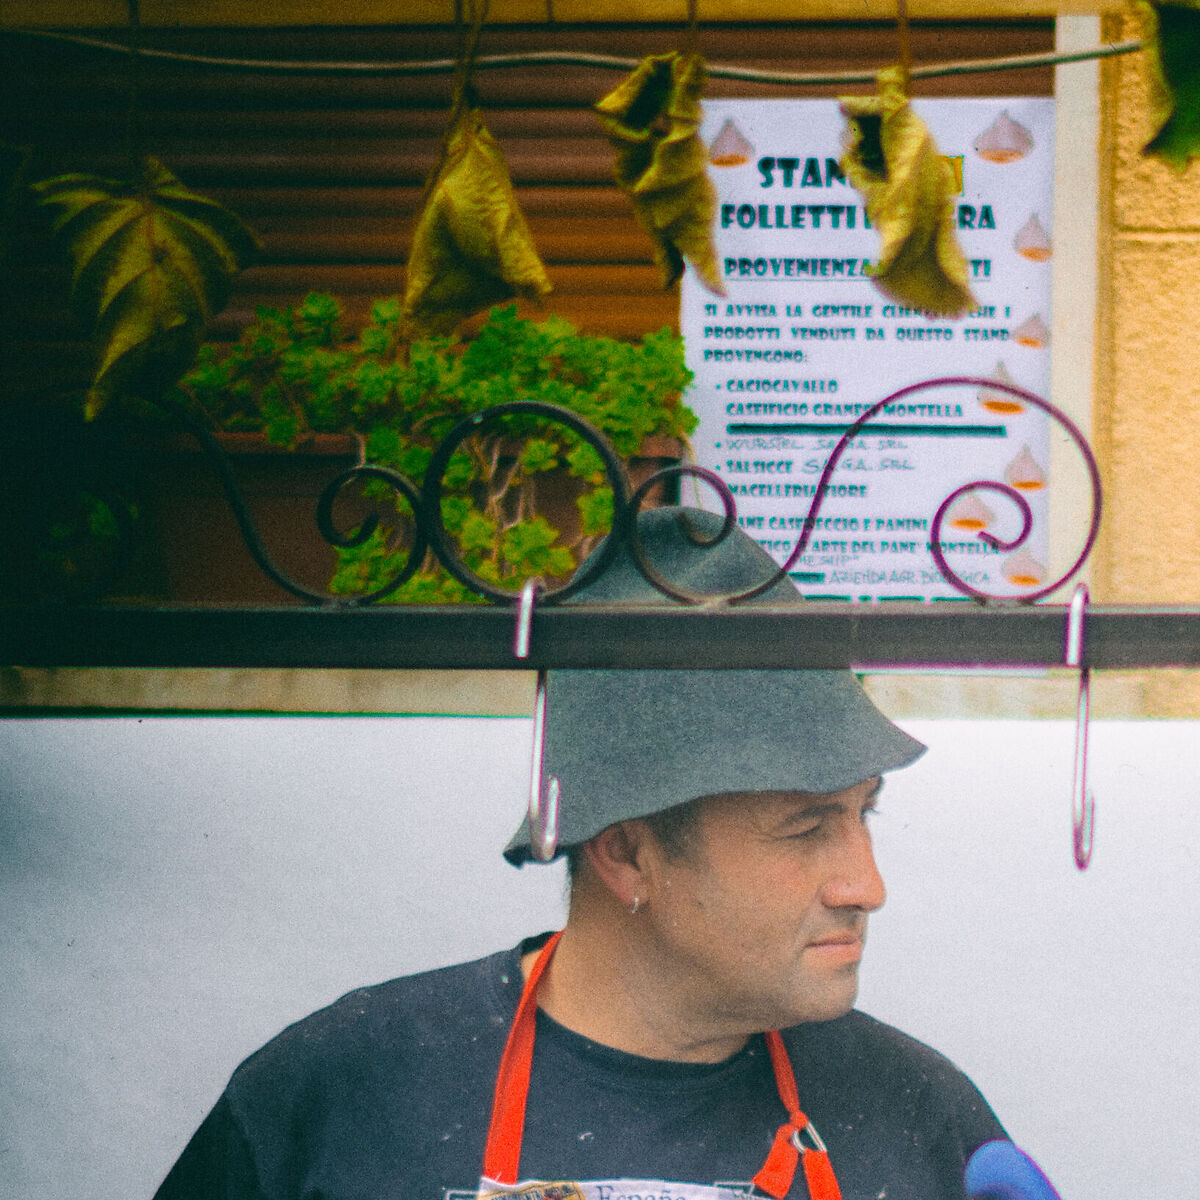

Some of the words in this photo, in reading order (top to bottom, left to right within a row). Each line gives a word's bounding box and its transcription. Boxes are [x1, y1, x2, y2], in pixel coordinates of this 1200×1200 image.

[757, 156, 848, 188] STAN
[721, 203, 857, 229] FOLLETTI
[704, 303, 717, 316] SI
[726, 303, 777, 317] AVVISA
[785, 304, 802, 317] LA
[811, 304, 872, 318] GENTILE
[704, 326, 780, 340] PRODOTTI
[790, 327, 856, 340] VENDUTI
[865, 327, 884, 340] DA
[896, 327, 954, 341] QUESTO
[964, 328, 1010, 341] STAND
[726, 379, 838, 393] CACIOCAVALLO
[813, 402, 877, 417] GRANES
[726, 459, 793, 474] SALSICCE
[738, 516, 764, 530] ANE
[768, 516, 859, 531] CASEECCIO
[876, 518, 928, 531] PANINI
[813, 540, 848, 553] ARTE
[852, 541, 875, 553] DEL
